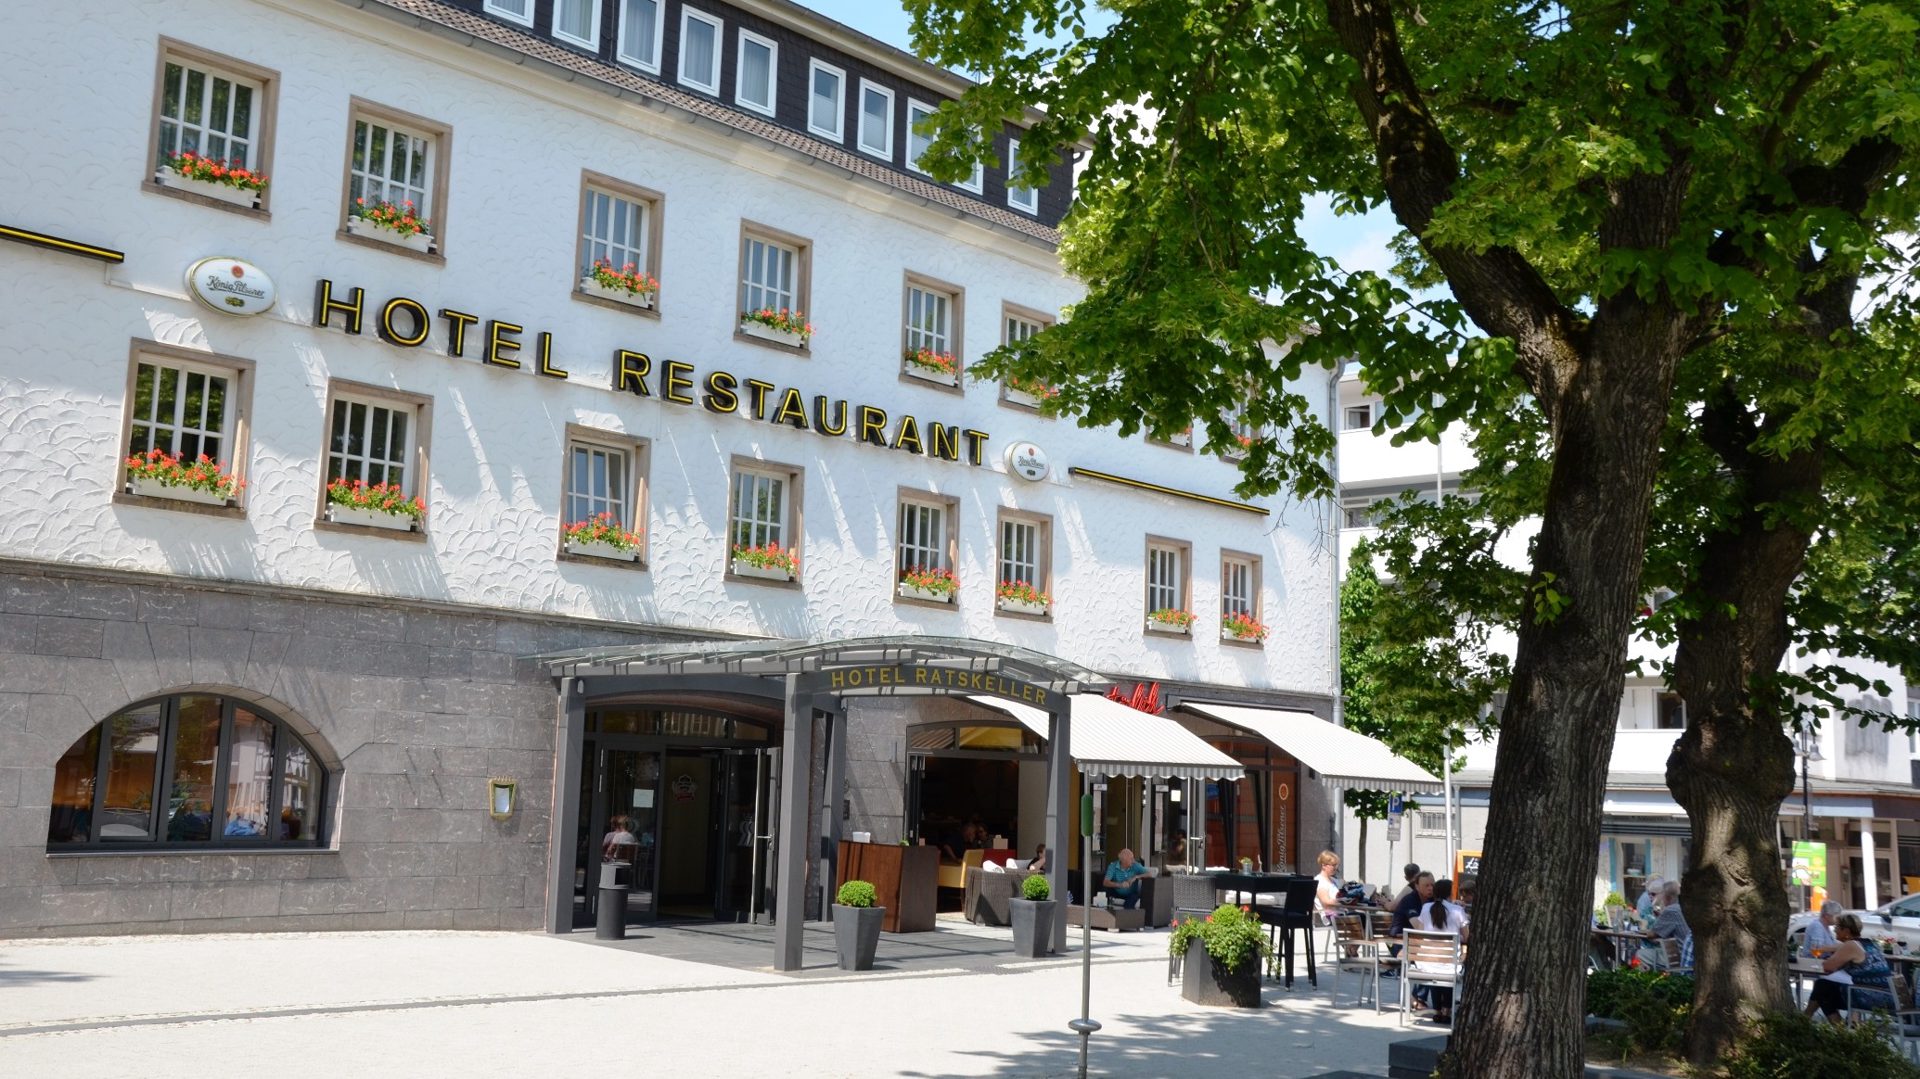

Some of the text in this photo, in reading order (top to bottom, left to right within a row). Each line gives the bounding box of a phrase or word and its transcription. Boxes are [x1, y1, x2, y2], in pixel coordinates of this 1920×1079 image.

[206, 275, 233, 292] König
[313, 278, 990, 466] HOTEL RESTAURANT
[831, 666, 1046, 705] HOTEL RATSKELLER
